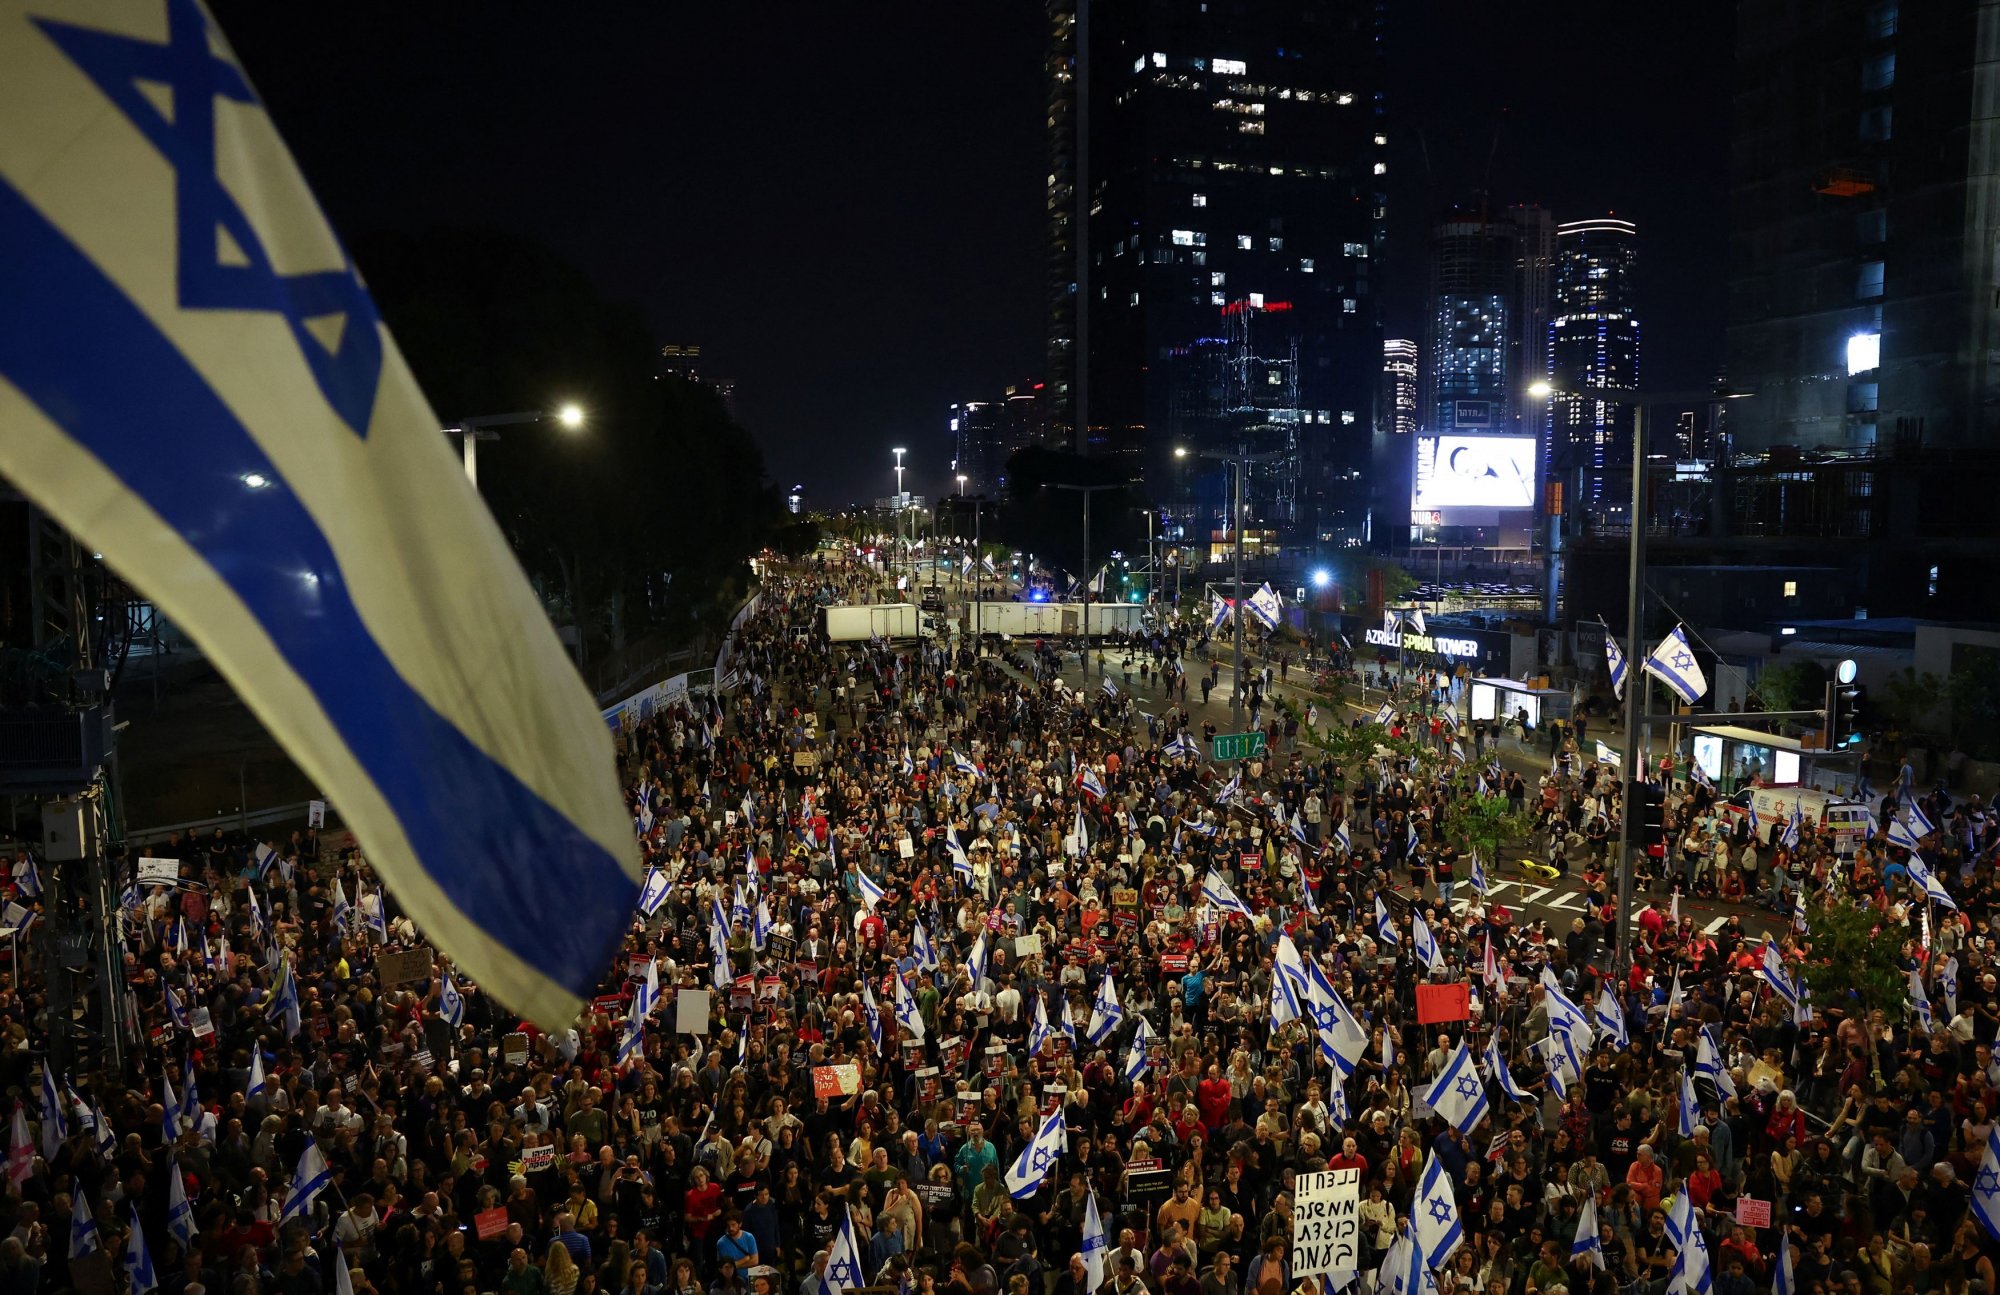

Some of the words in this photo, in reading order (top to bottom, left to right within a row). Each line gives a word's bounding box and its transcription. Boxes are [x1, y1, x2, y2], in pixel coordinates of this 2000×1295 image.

[1366, 629, 1401, 648] AZRIELI
[1403, 633, 1436, 653] SPIRAL
[1436, 637, 1478, 657] TOWER
[1114, 891, 1136, 903] עכשיו
[770, 948, 783, 959] NOW
[771, 941, 783, 952] DEAL
[1611, 1139, 1629, 1148] FCK
[532, 1147, 554, 1158] נתניהו
[1316, 1169, 1358, 1189] ננצח
[1296, 1200, 1355, 1221] ממשלה
[1298, 1220, 1355, 1242] בוגדת
[1294, 1243, 1353, 1271] בעמה
